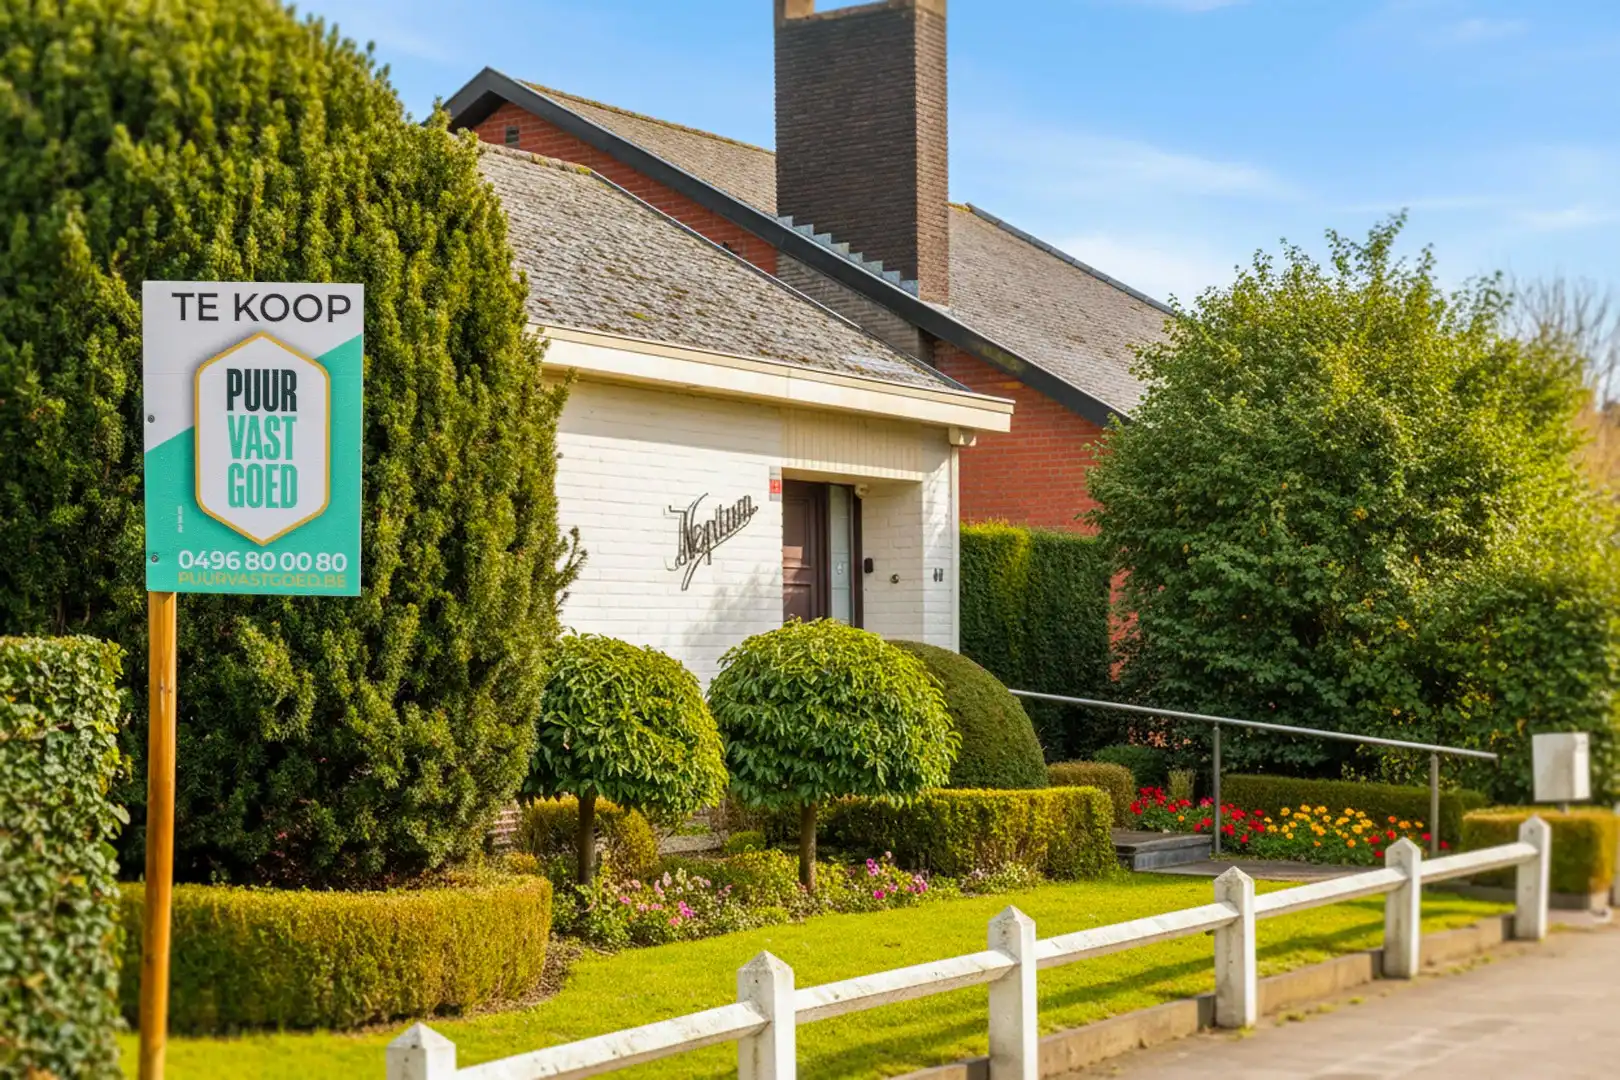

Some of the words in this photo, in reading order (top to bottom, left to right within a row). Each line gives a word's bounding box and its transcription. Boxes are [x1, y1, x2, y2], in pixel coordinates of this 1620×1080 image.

[171, 292, 219, 322] TE
[234, 292, 351, 323] KOOP
[226, 368, 298, 413] PUUR
[226, 414, 298, 461] VAST
[227, 463, 298, 509] GOED
[177, 571, 348, 589] PUURVASTGOED.BE
[178, 549, 241, 571] 0496
[245, 551, 276, 571] 80
[280, 552, 312, 572] 00
[315, 552, 348, 573] 80
